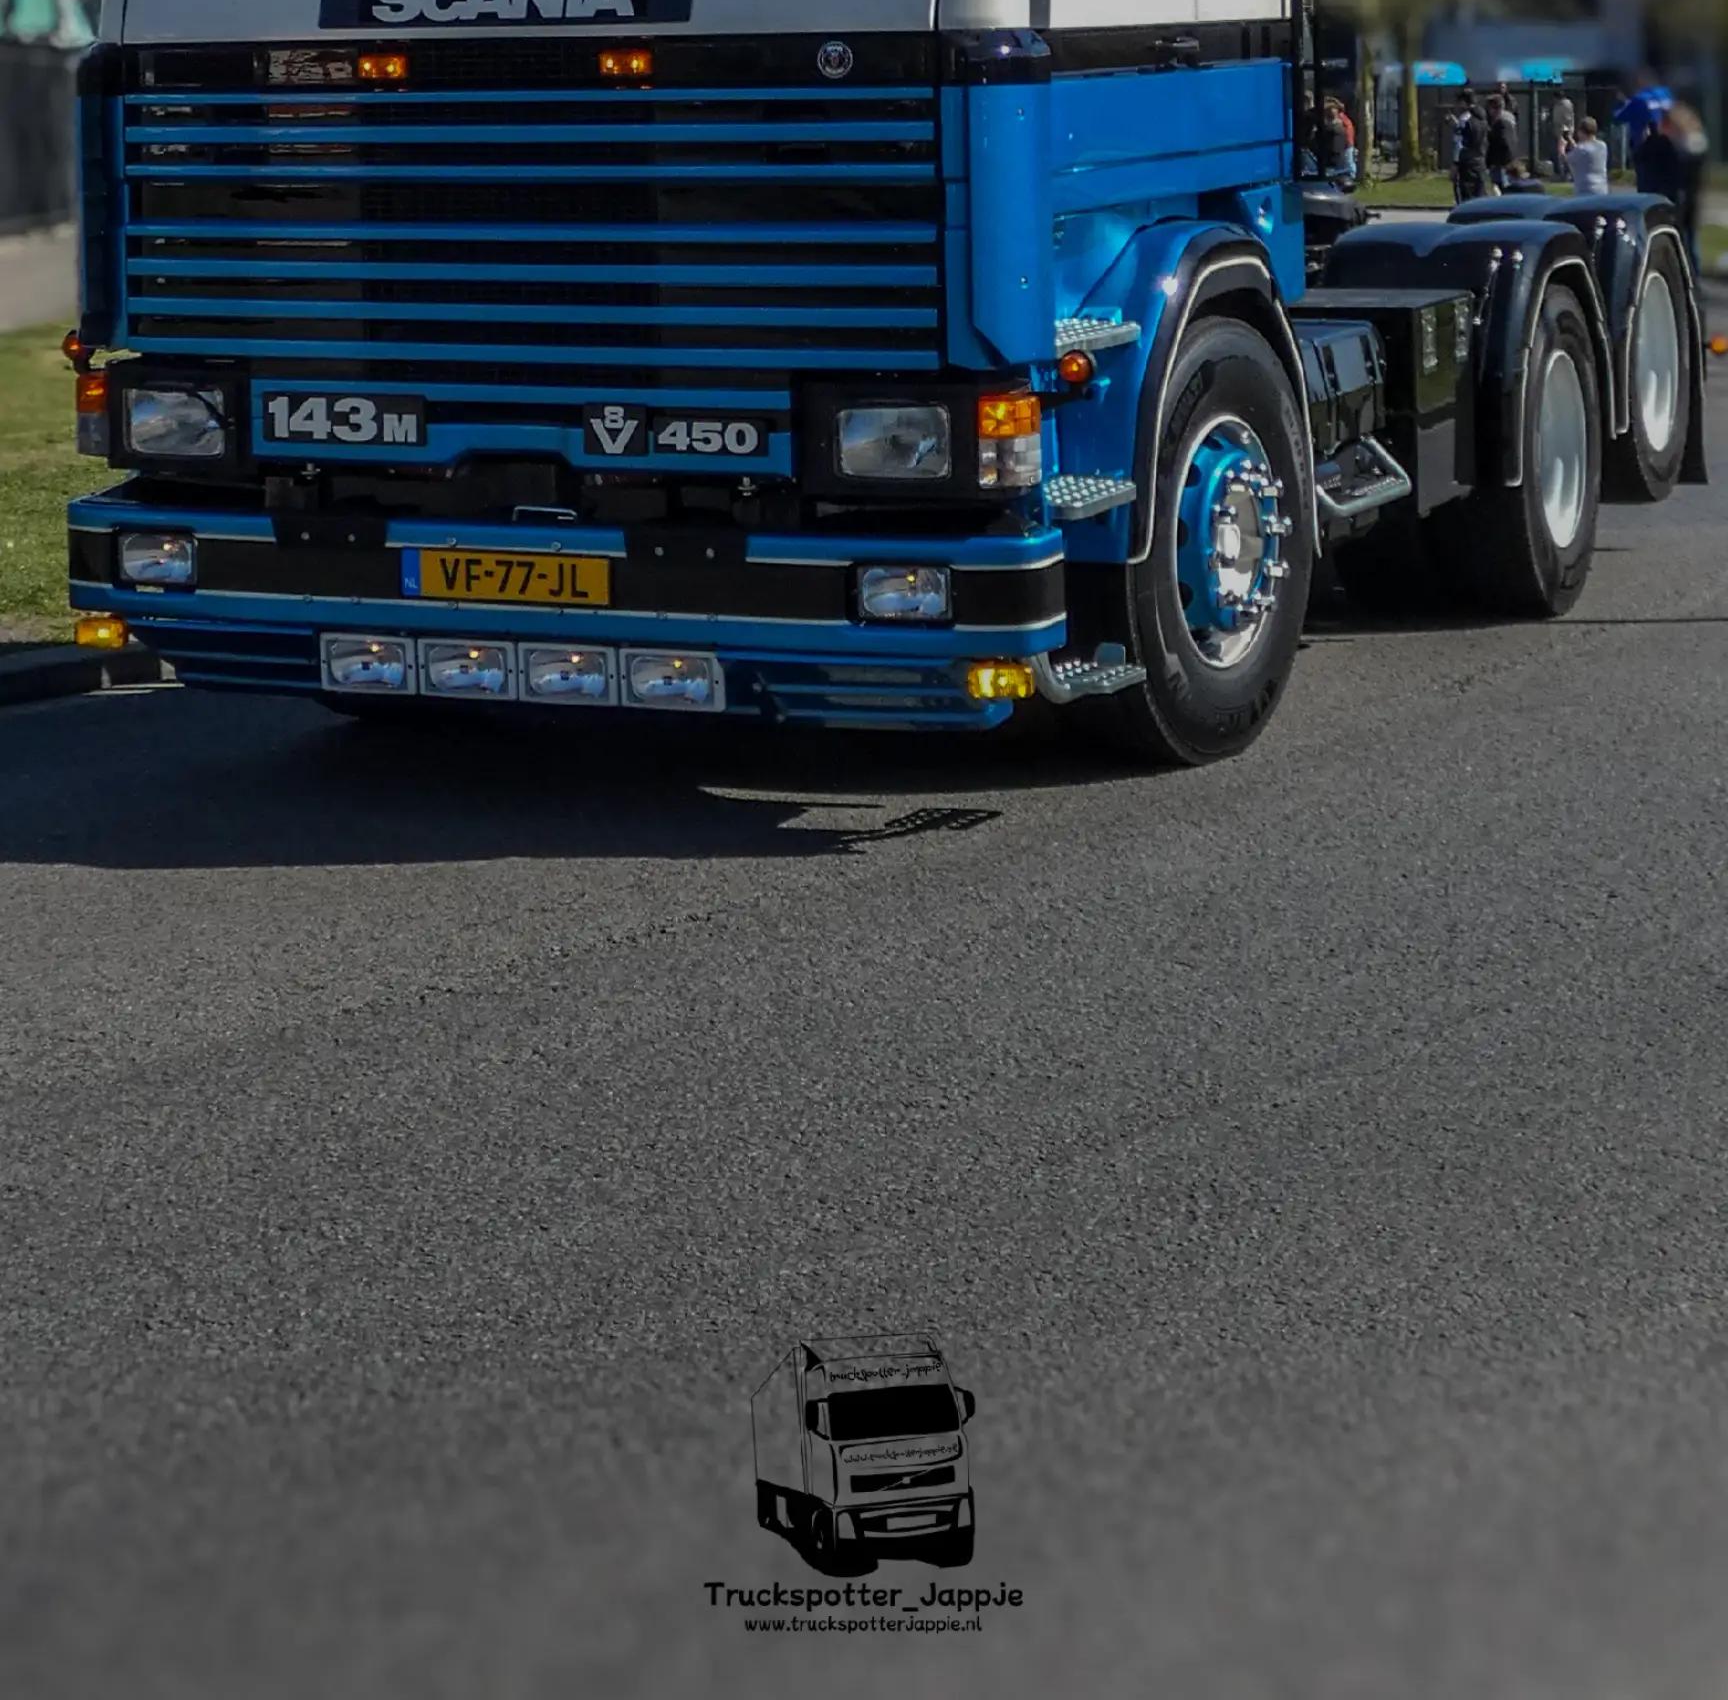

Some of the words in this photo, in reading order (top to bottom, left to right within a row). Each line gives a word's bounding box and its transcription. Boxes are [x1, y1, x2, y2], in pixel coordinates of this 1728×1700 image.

[657, 421, 758, 454] 450
[404, 577, 418, 589] NL
[440, 557, 589, 598] VF-77-JL
